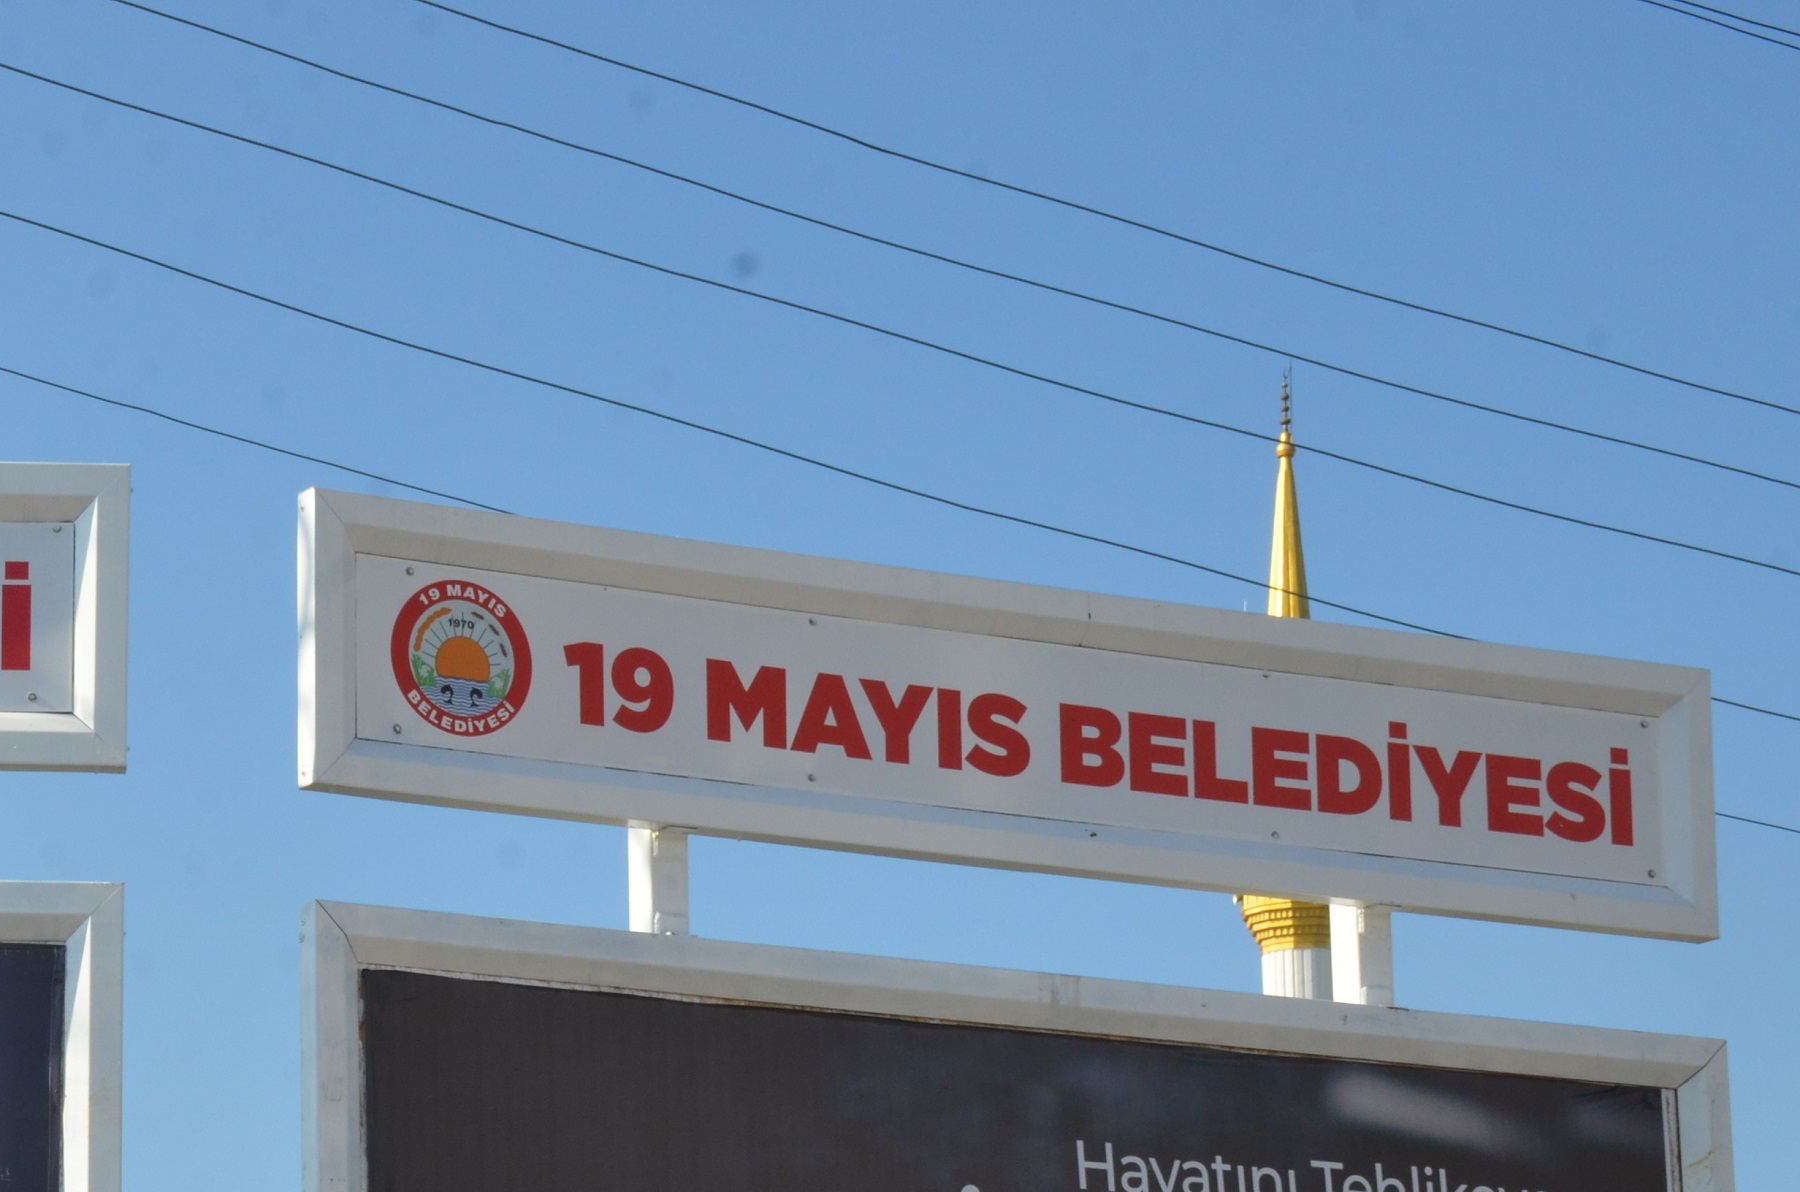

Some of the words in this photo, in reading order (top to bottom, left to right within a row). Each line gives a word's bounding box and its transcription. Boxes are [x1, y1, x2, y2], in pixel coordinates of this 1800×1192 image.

[418, 587, 441, 606] 19
[446, 584, 507, 618] MAYIS
[448, 618, 475, 630] 1970
[407, 689, 516, 733] BELEDİYESİ
[562, 641, 675, 734] 19
[705, 657, 1031, 778] MAYIS
[1058, 702, 1634, 848] BELEDİYESİ
